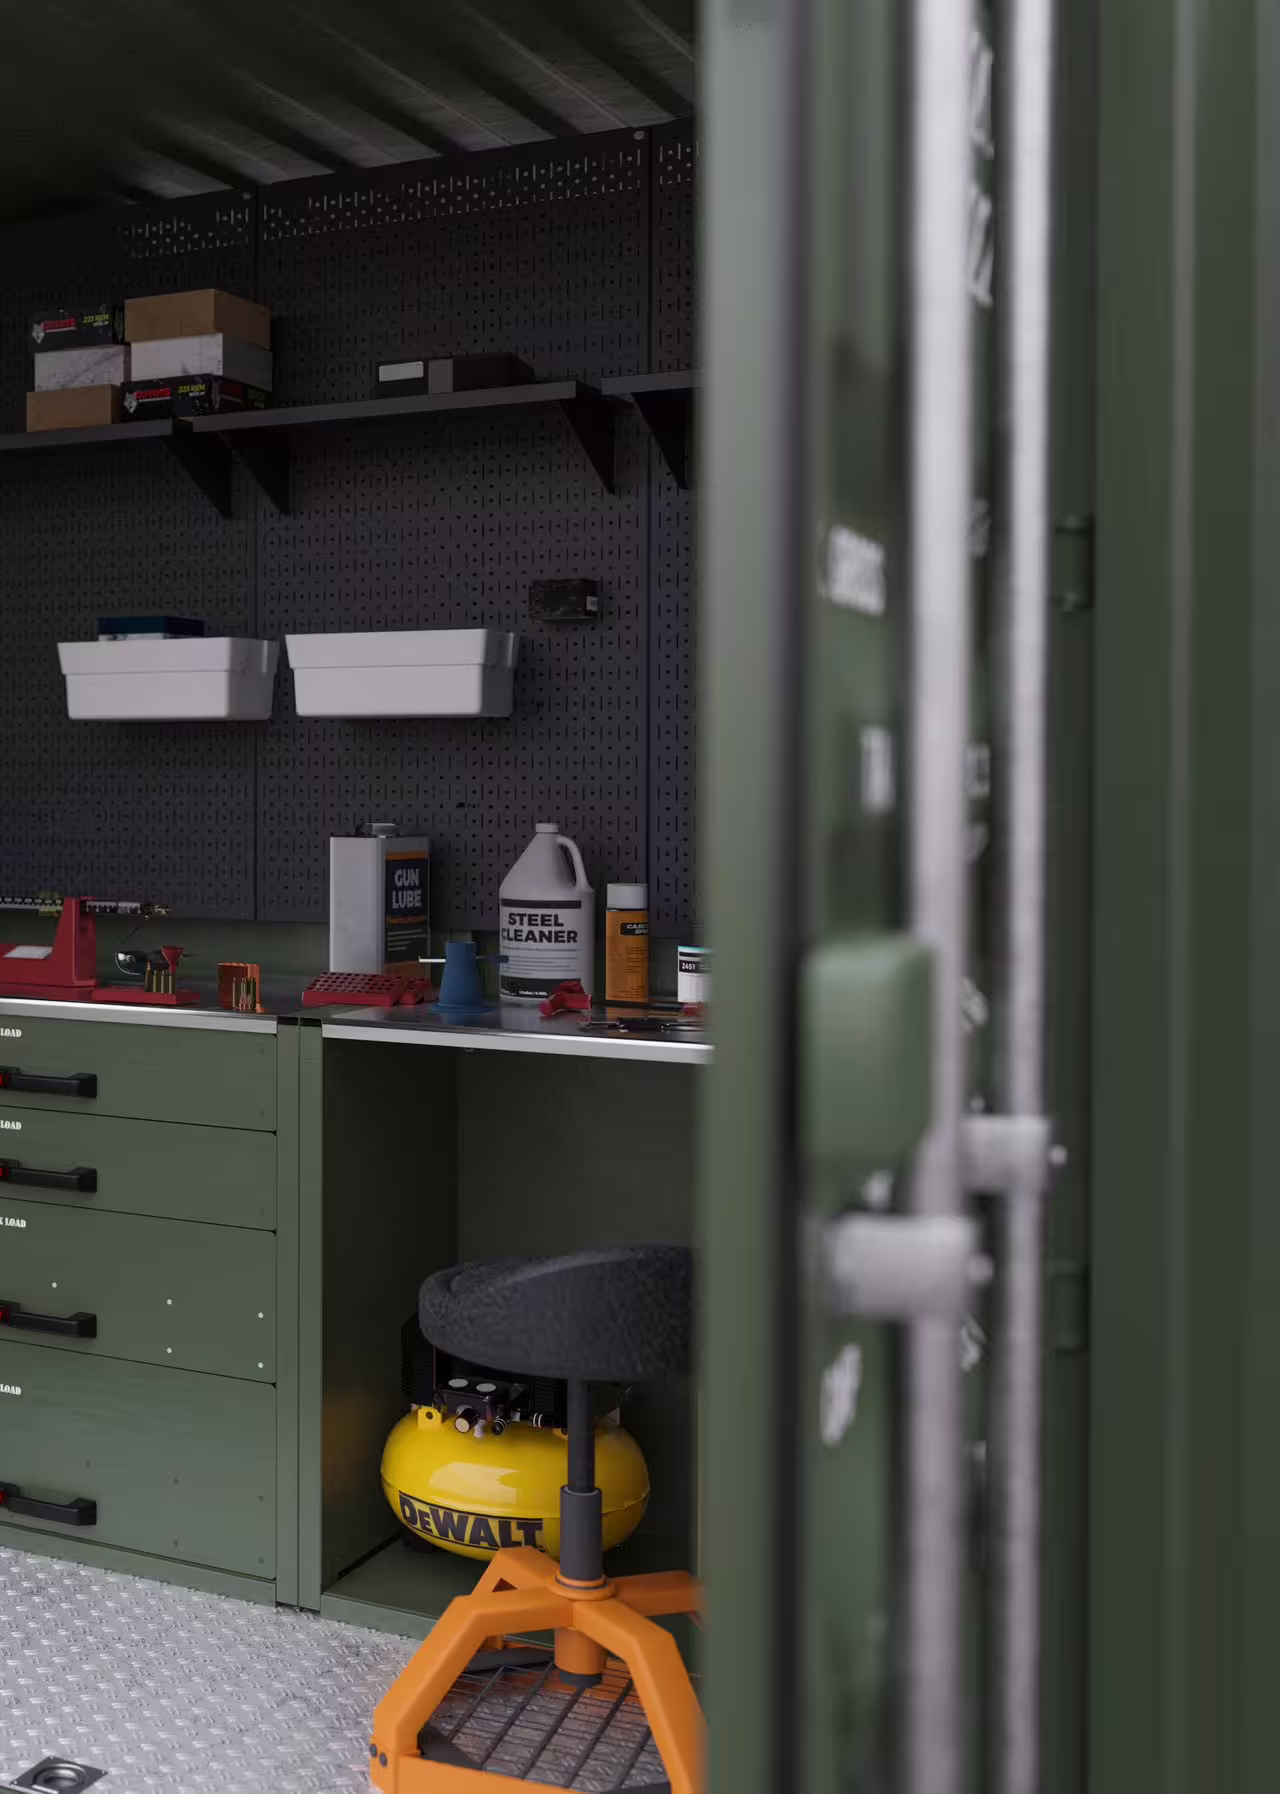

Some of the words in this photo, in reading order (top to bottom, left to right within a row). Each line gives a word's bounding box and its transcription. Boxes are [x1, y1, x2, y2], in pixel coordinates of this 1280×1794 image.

[394, 869, 420, 887] GUN
[392, 890, 422, 909] LUBE
[508, 912, 564, 927] STEEL
[501, 928, 578, 943] CLEANER
[0, 1027, 22, 1038] LOAD
[0, 1120, 22, 1130] LOAD
[4, 1217, 27, 1228] LOAD
[0, 1383, 22, 1395] LOAD
